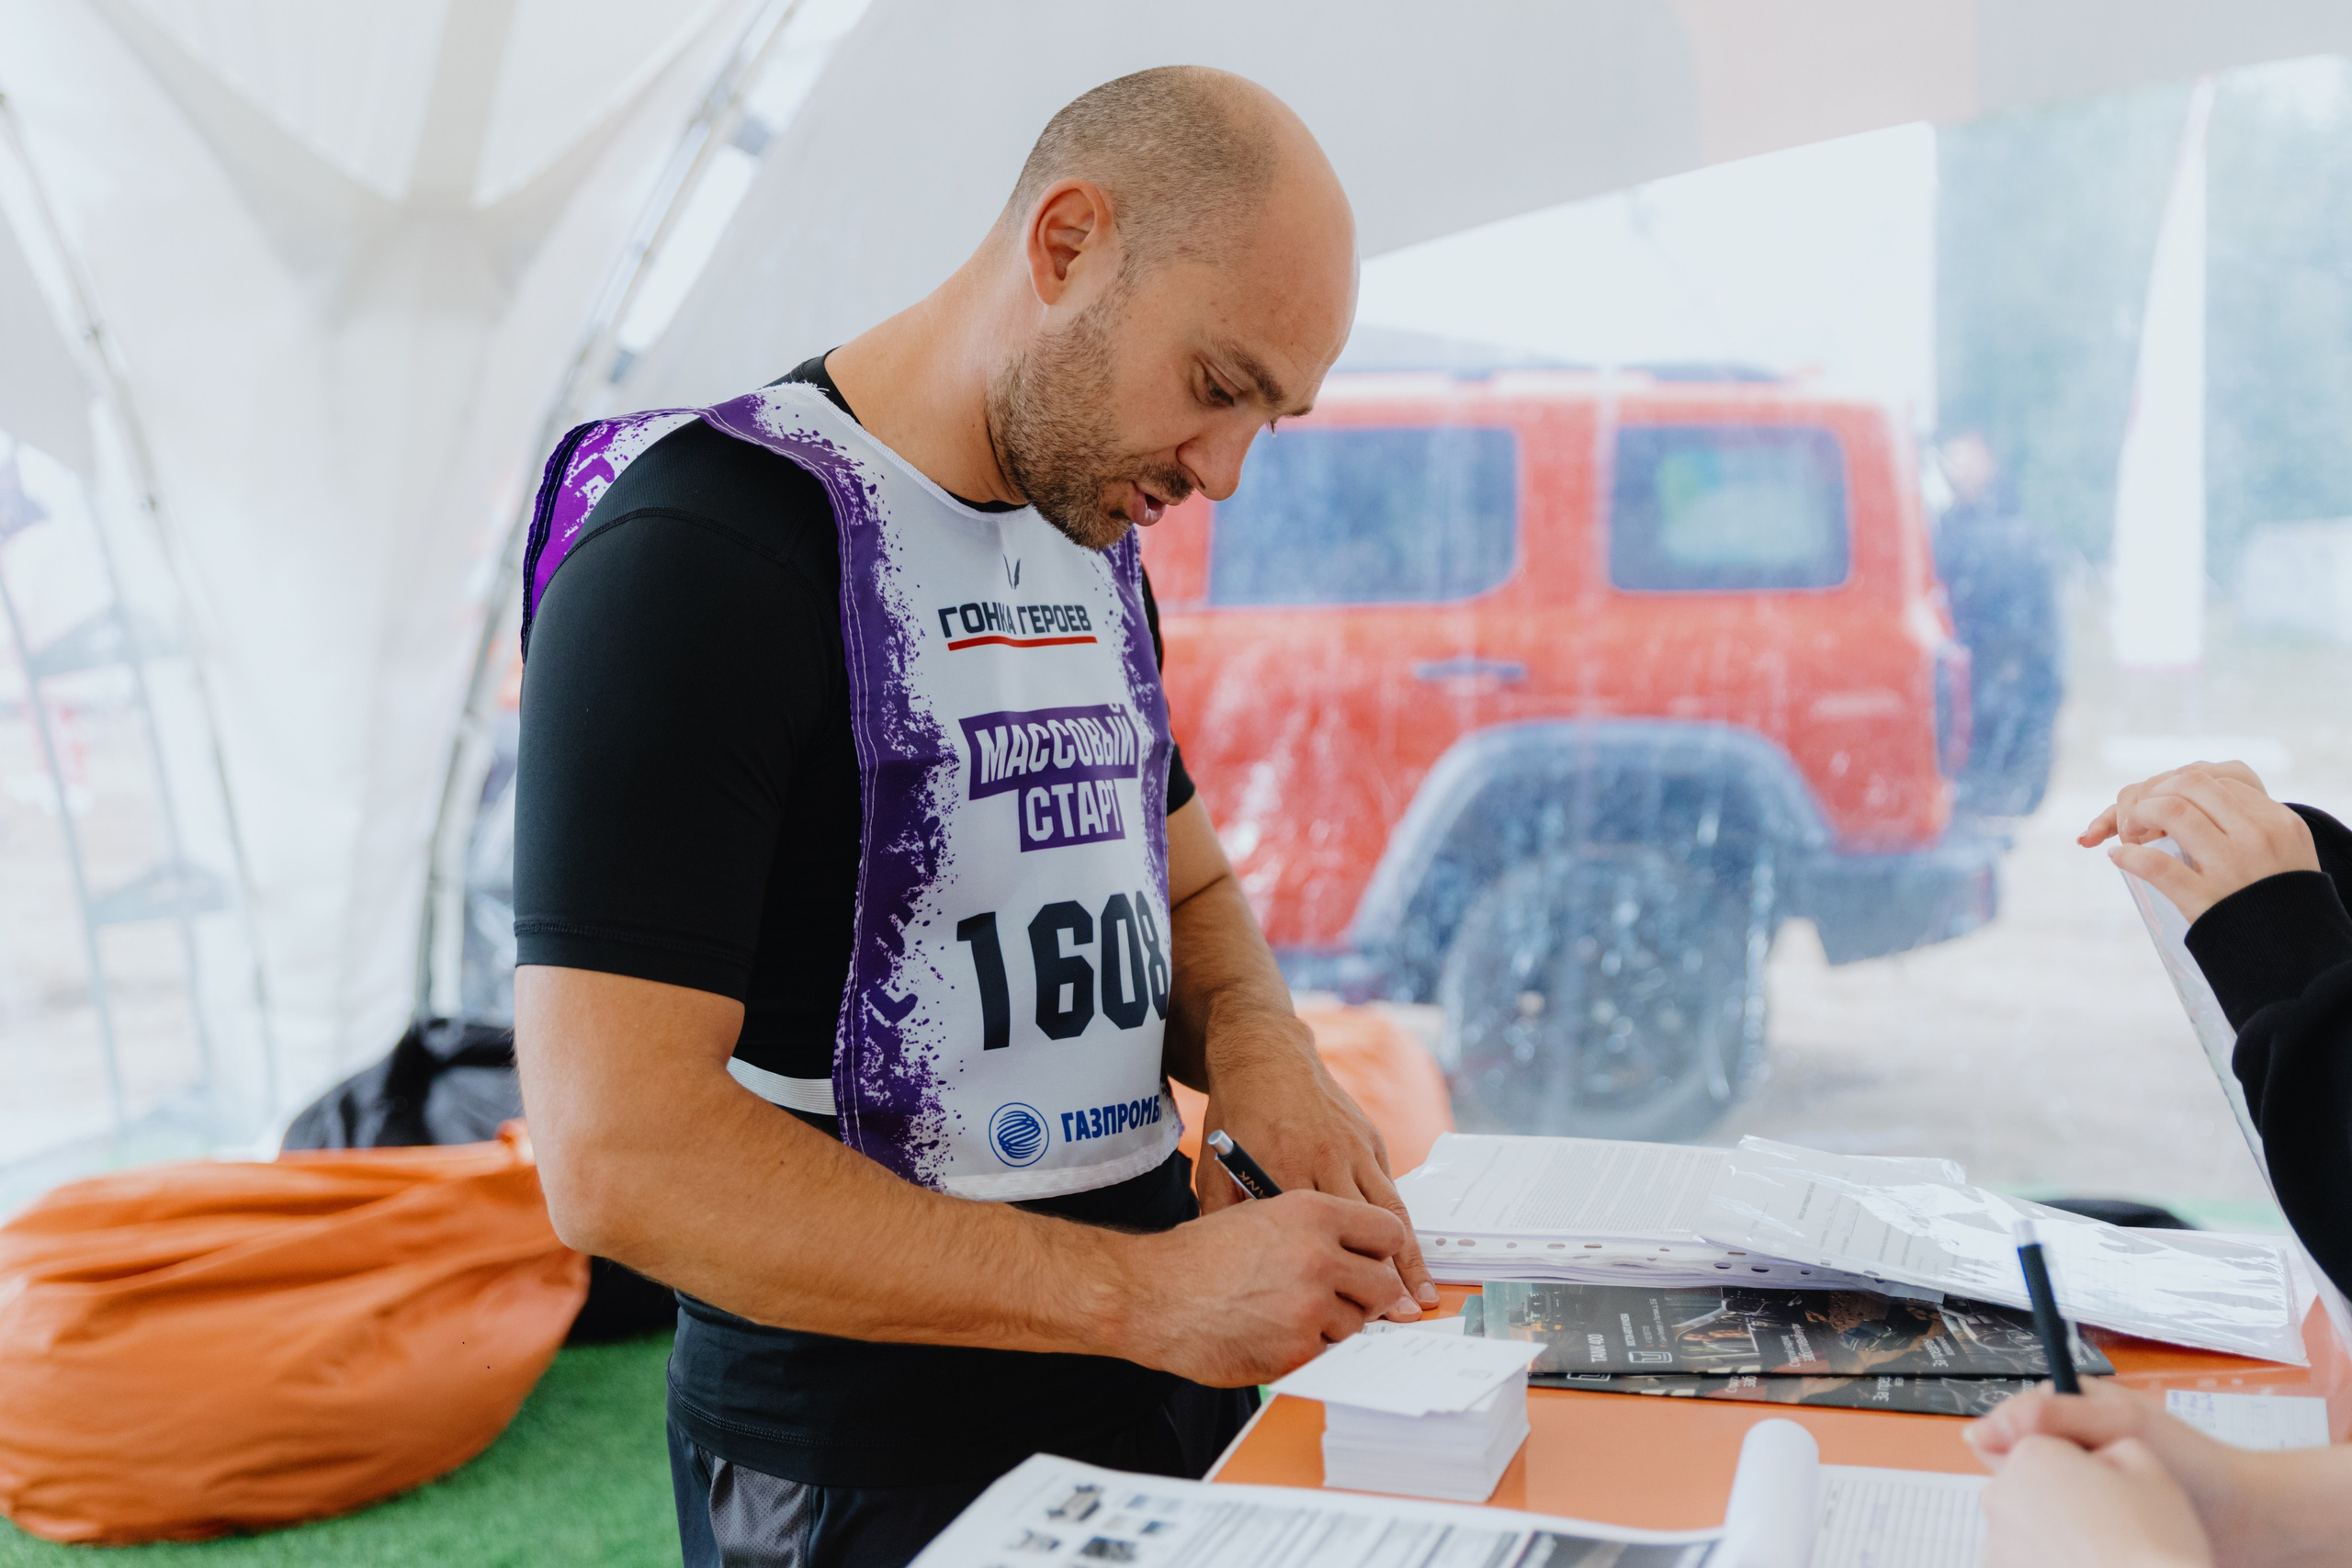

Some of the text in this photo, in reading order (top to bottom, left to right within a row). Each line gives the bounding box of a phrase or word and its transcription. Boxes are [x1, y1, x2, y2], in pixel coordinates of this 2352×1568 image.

[937, 602, 1092, 638] ГОНКА ГЕРОЕВ
[974, 703, 1136, 784] МАССОВЫЙ
[1025, 779, 1121, 842] СТАРТ
[956, 890, 1169, 1051] 1608
[1060, 1094, 1162, 1143] ГАЗПРОМБ
[1587, 1334, 1608, 1363] TANK 400
